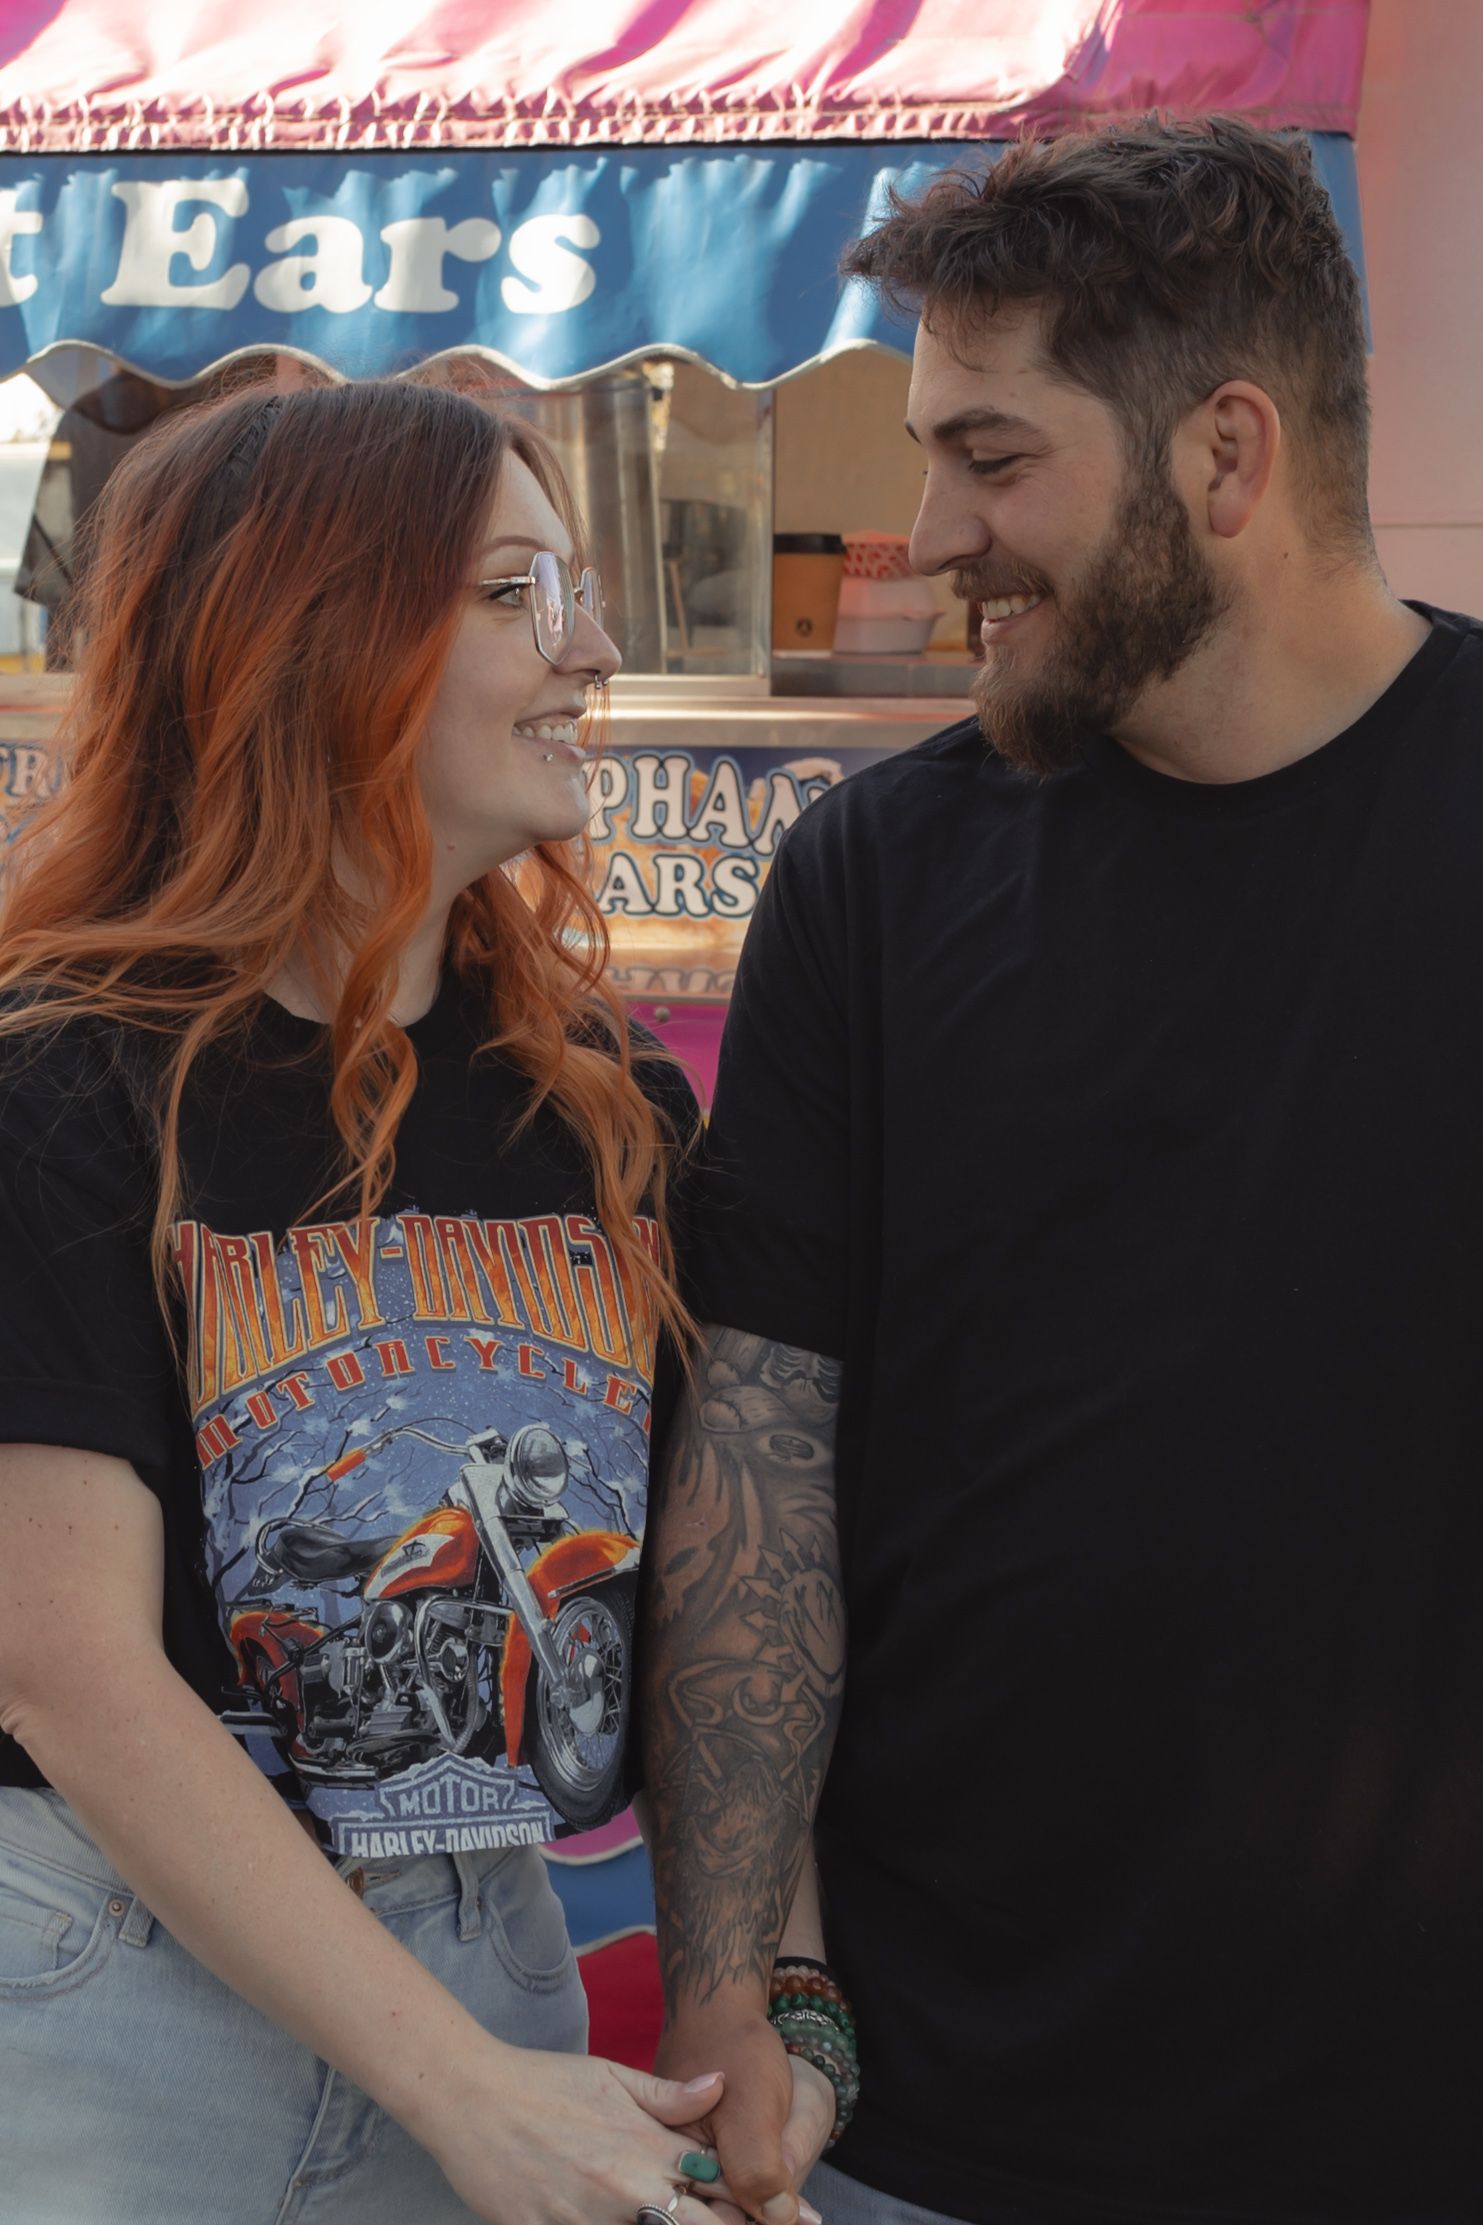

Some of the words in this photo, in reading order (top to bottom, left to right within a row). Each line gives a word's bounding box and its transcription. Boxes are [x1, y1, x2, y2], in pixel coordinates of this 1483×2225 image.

[101, 177, 601, 314] Ears
[196, 1334, 651, 1470] MOTORCYCLE
[400, 1774, 501, 1817] MOTOR
